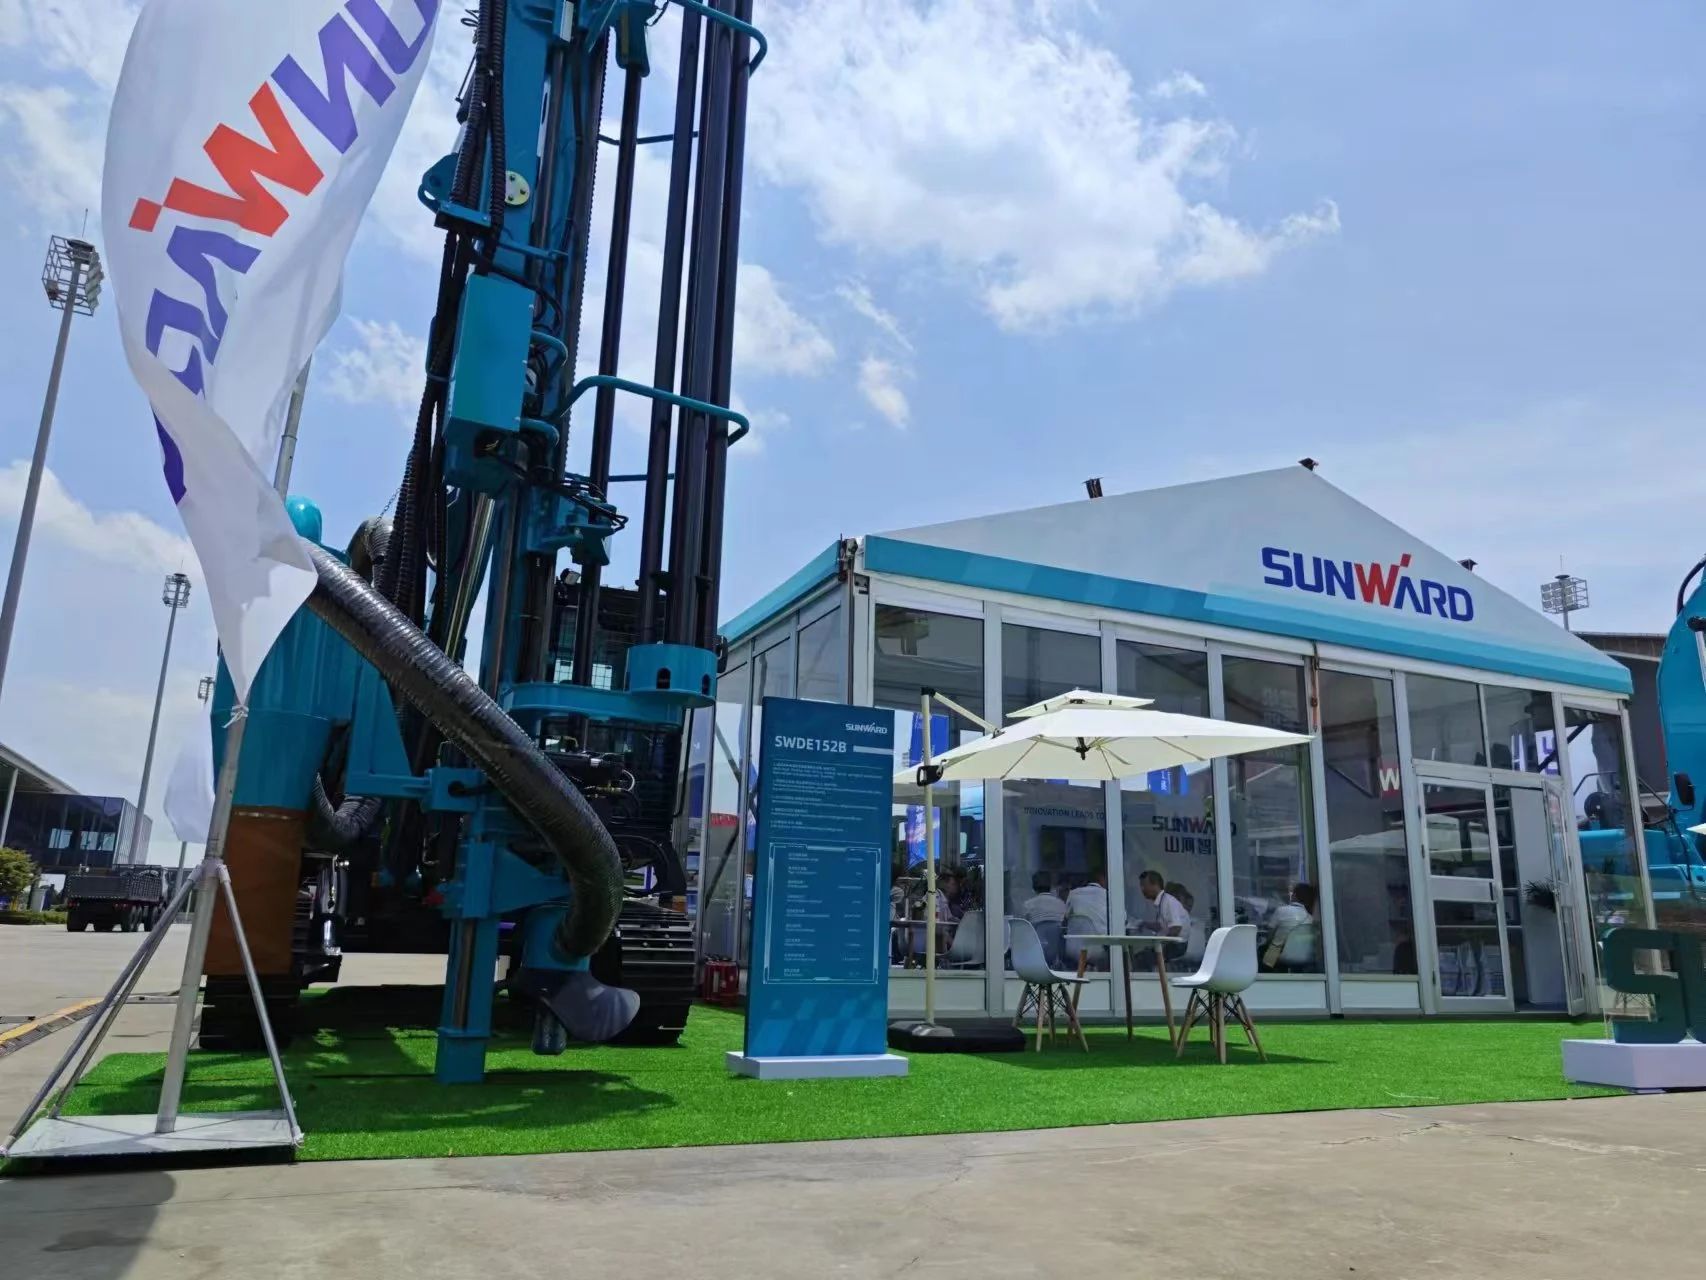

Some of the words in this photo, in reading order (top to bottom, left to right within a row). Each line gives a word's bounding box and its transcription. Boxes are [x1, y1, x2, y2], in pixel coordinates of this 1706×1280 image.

[1261, 547, 1474, 622] SUNWARD
[845, 722, 888, 734] SUNWARD
[774, 735, 847, 753] SWDE152B
